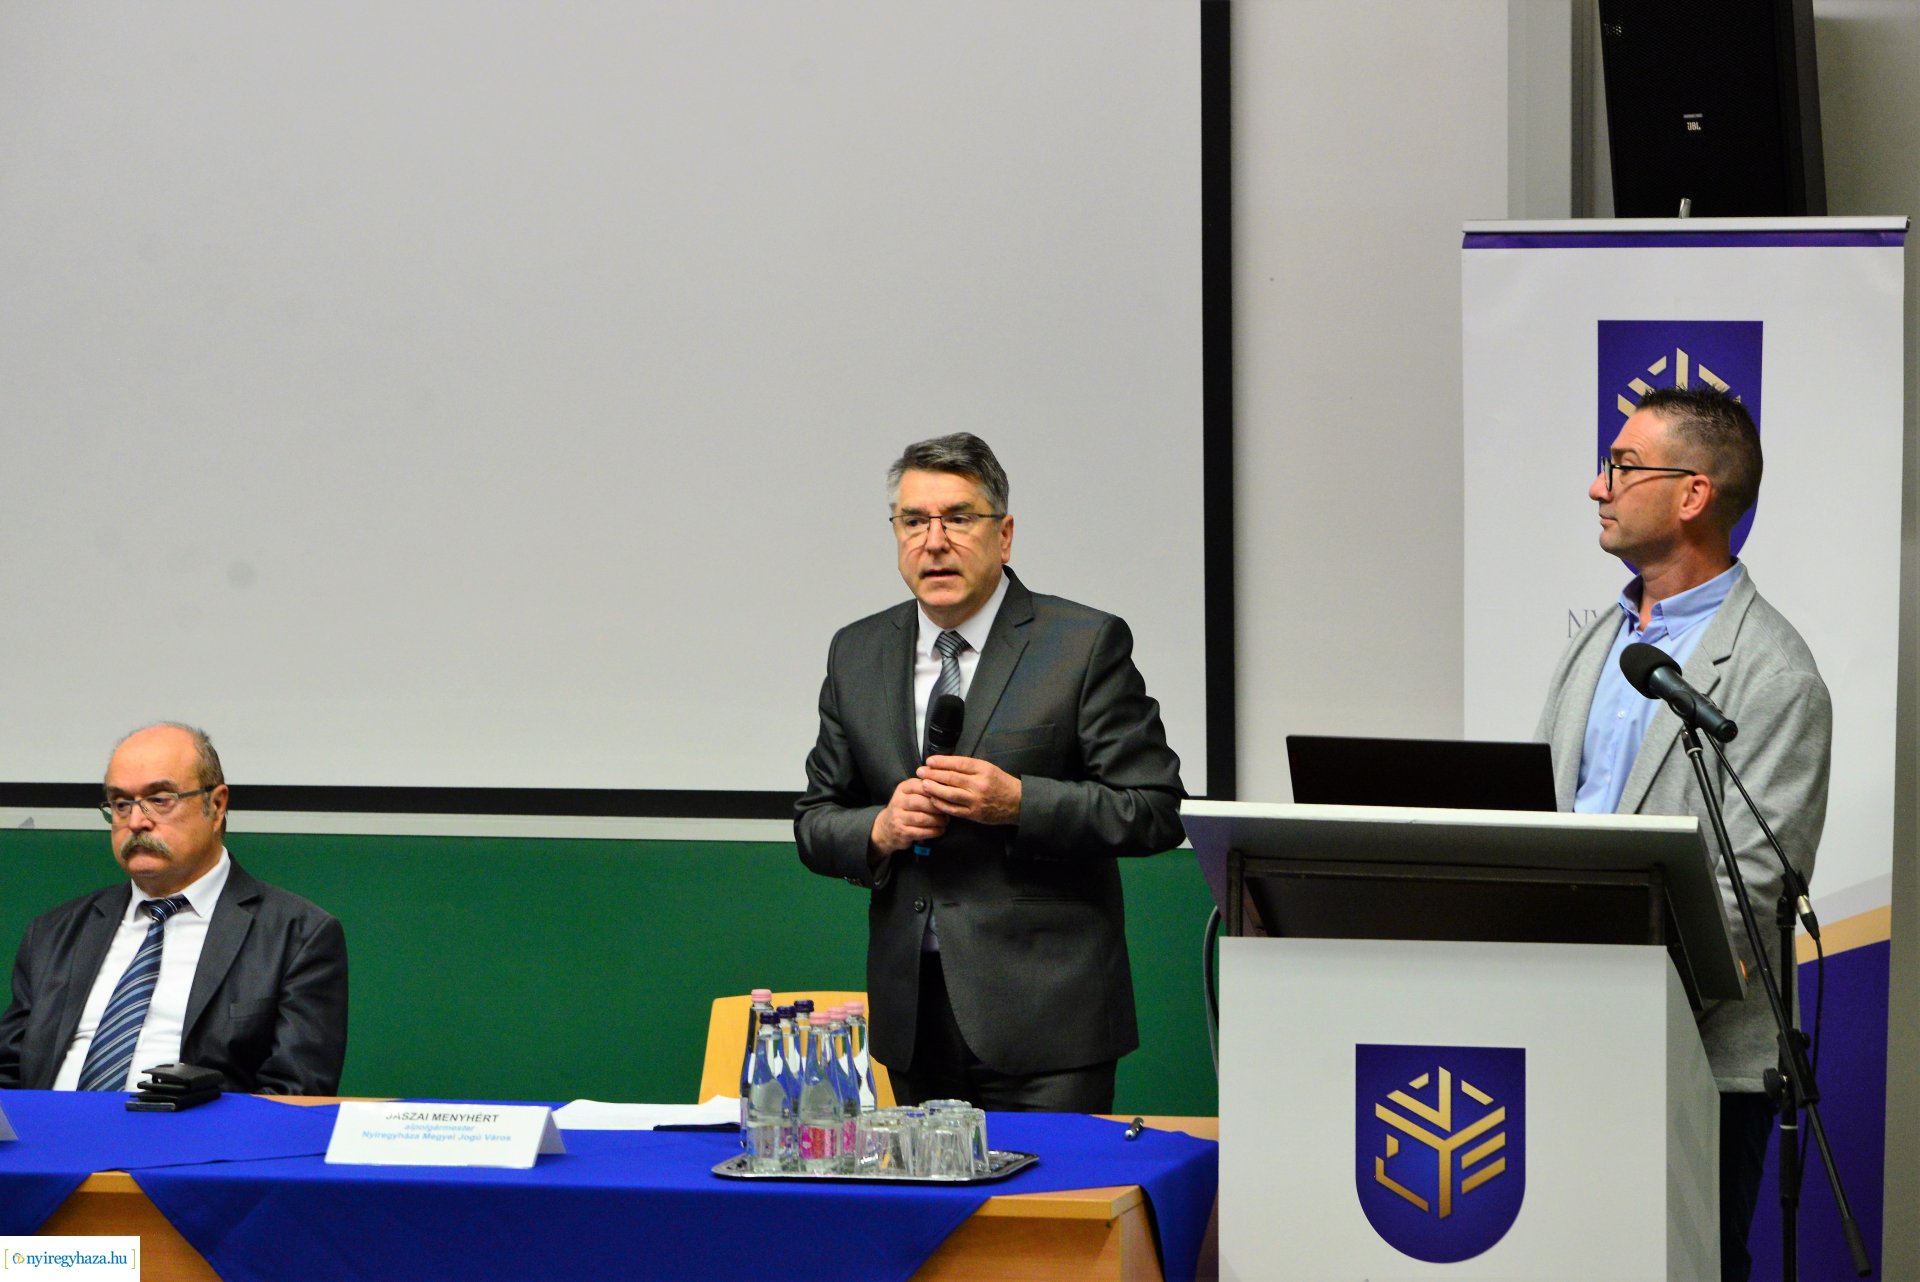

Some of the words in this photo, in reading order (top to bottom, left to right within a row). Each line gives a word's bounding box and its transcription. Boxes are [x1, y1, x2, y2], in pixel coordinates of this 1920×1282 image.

[1686, 121, 1701, 131] JBL
[1568, 608, 1597, 638] N
[432, 1112, 500, 1123] MENYHÉRT
